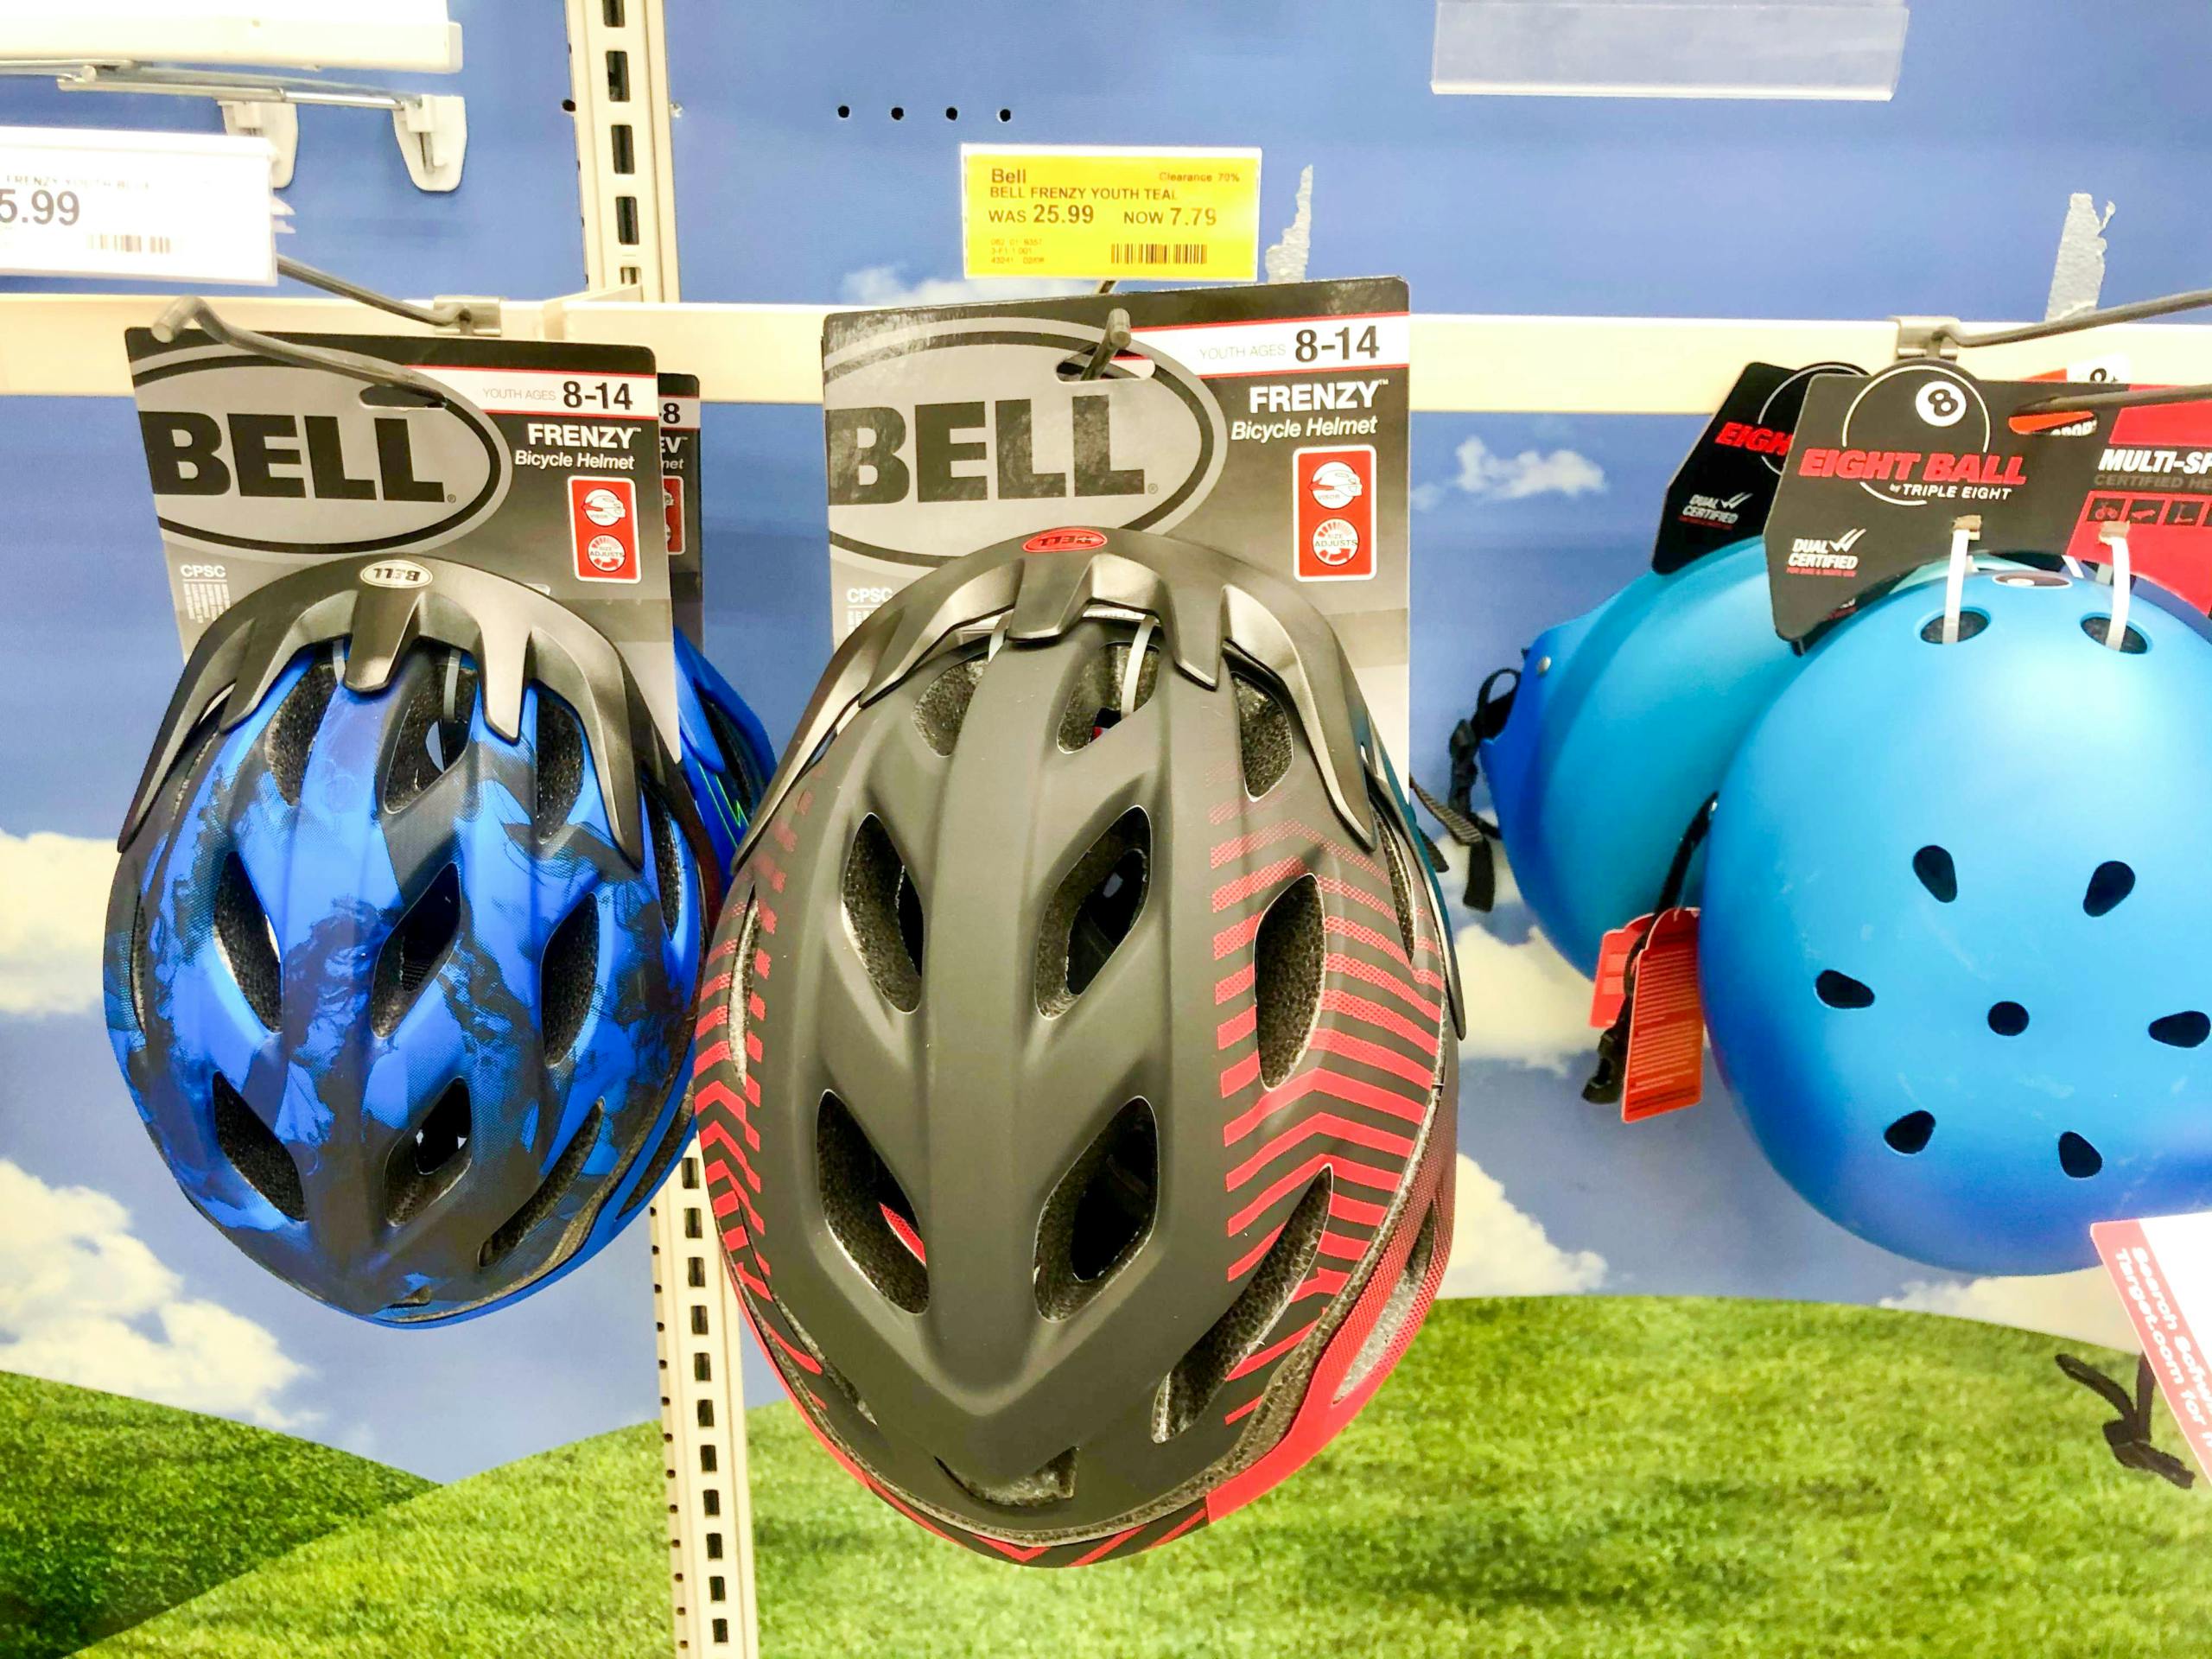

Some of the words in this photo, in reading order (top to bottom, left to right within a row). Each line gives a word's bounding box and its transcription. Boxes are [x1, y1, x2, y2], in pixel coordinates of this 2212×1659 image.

[991, 168, 1027, 184] Bell
[1159, 171, 1213, 182] Clearance
[1218, 173, 1241, 182] 70%
[990, 186, 1026, 199] BELL
[1031, 187, 1087, 200] FRENZY
[1091, 188, 1140, 200] YOUTH
[1144, 188, 1177, 200] TEAL
[988, 210, 1027, 224] WAS
[1033, 203, 1095, 225] 25.99
[1123, 211, 1165, 225] NOW
[1169, 207, 1217, 226] 7.79
[1199, 346, 1246, 360] YOUTH
[1250, 344, 1287, 357] AGES
[1294, 325, 1381, 363] 8-14
[482, 388, 523, 399] YOUTH
[524, 390, 557, 401] AGES
[563, 380, 634, 410] 8-14
[1928, 389, 1959, 416] 8
[1230, 418, 1302, 444] Bicycle
[1306, 414, 1379, 437] Helmet
[1714, 422, 1794, 456] EIGH
[137, 410, 446, 504] BELL
[515, 449, 574, 470] Bicycle
[576, 452, 636, 471] Helmet
[825, 394, 1145, 506] BELL
[1798, 448, 1922, 481] EIGHT
[1923, 452, 2027, 486] BALL
[2094, 474, 2184, 488] CERTIFIED
[1903, 483, 1956, 499] TRIPLE
[1961, 486, 2012, 502] EIGHT
[1314, 539, 1358, 548] ADJUSTS
[1792, 537, 1828, 554] DUAL
[180, 564, 226, 578] CPSC
[1788, 552, 1859, 569] CERTIFIED
[846, 587, 893, 603] CPSC
[2115, 1248, 2185, 1385] Target.com
[2180, 1389, 2207, 1426] for
[2132, 1246, 2178, 1331] Search
[2174, 1335, 2212, 1415] Schw
